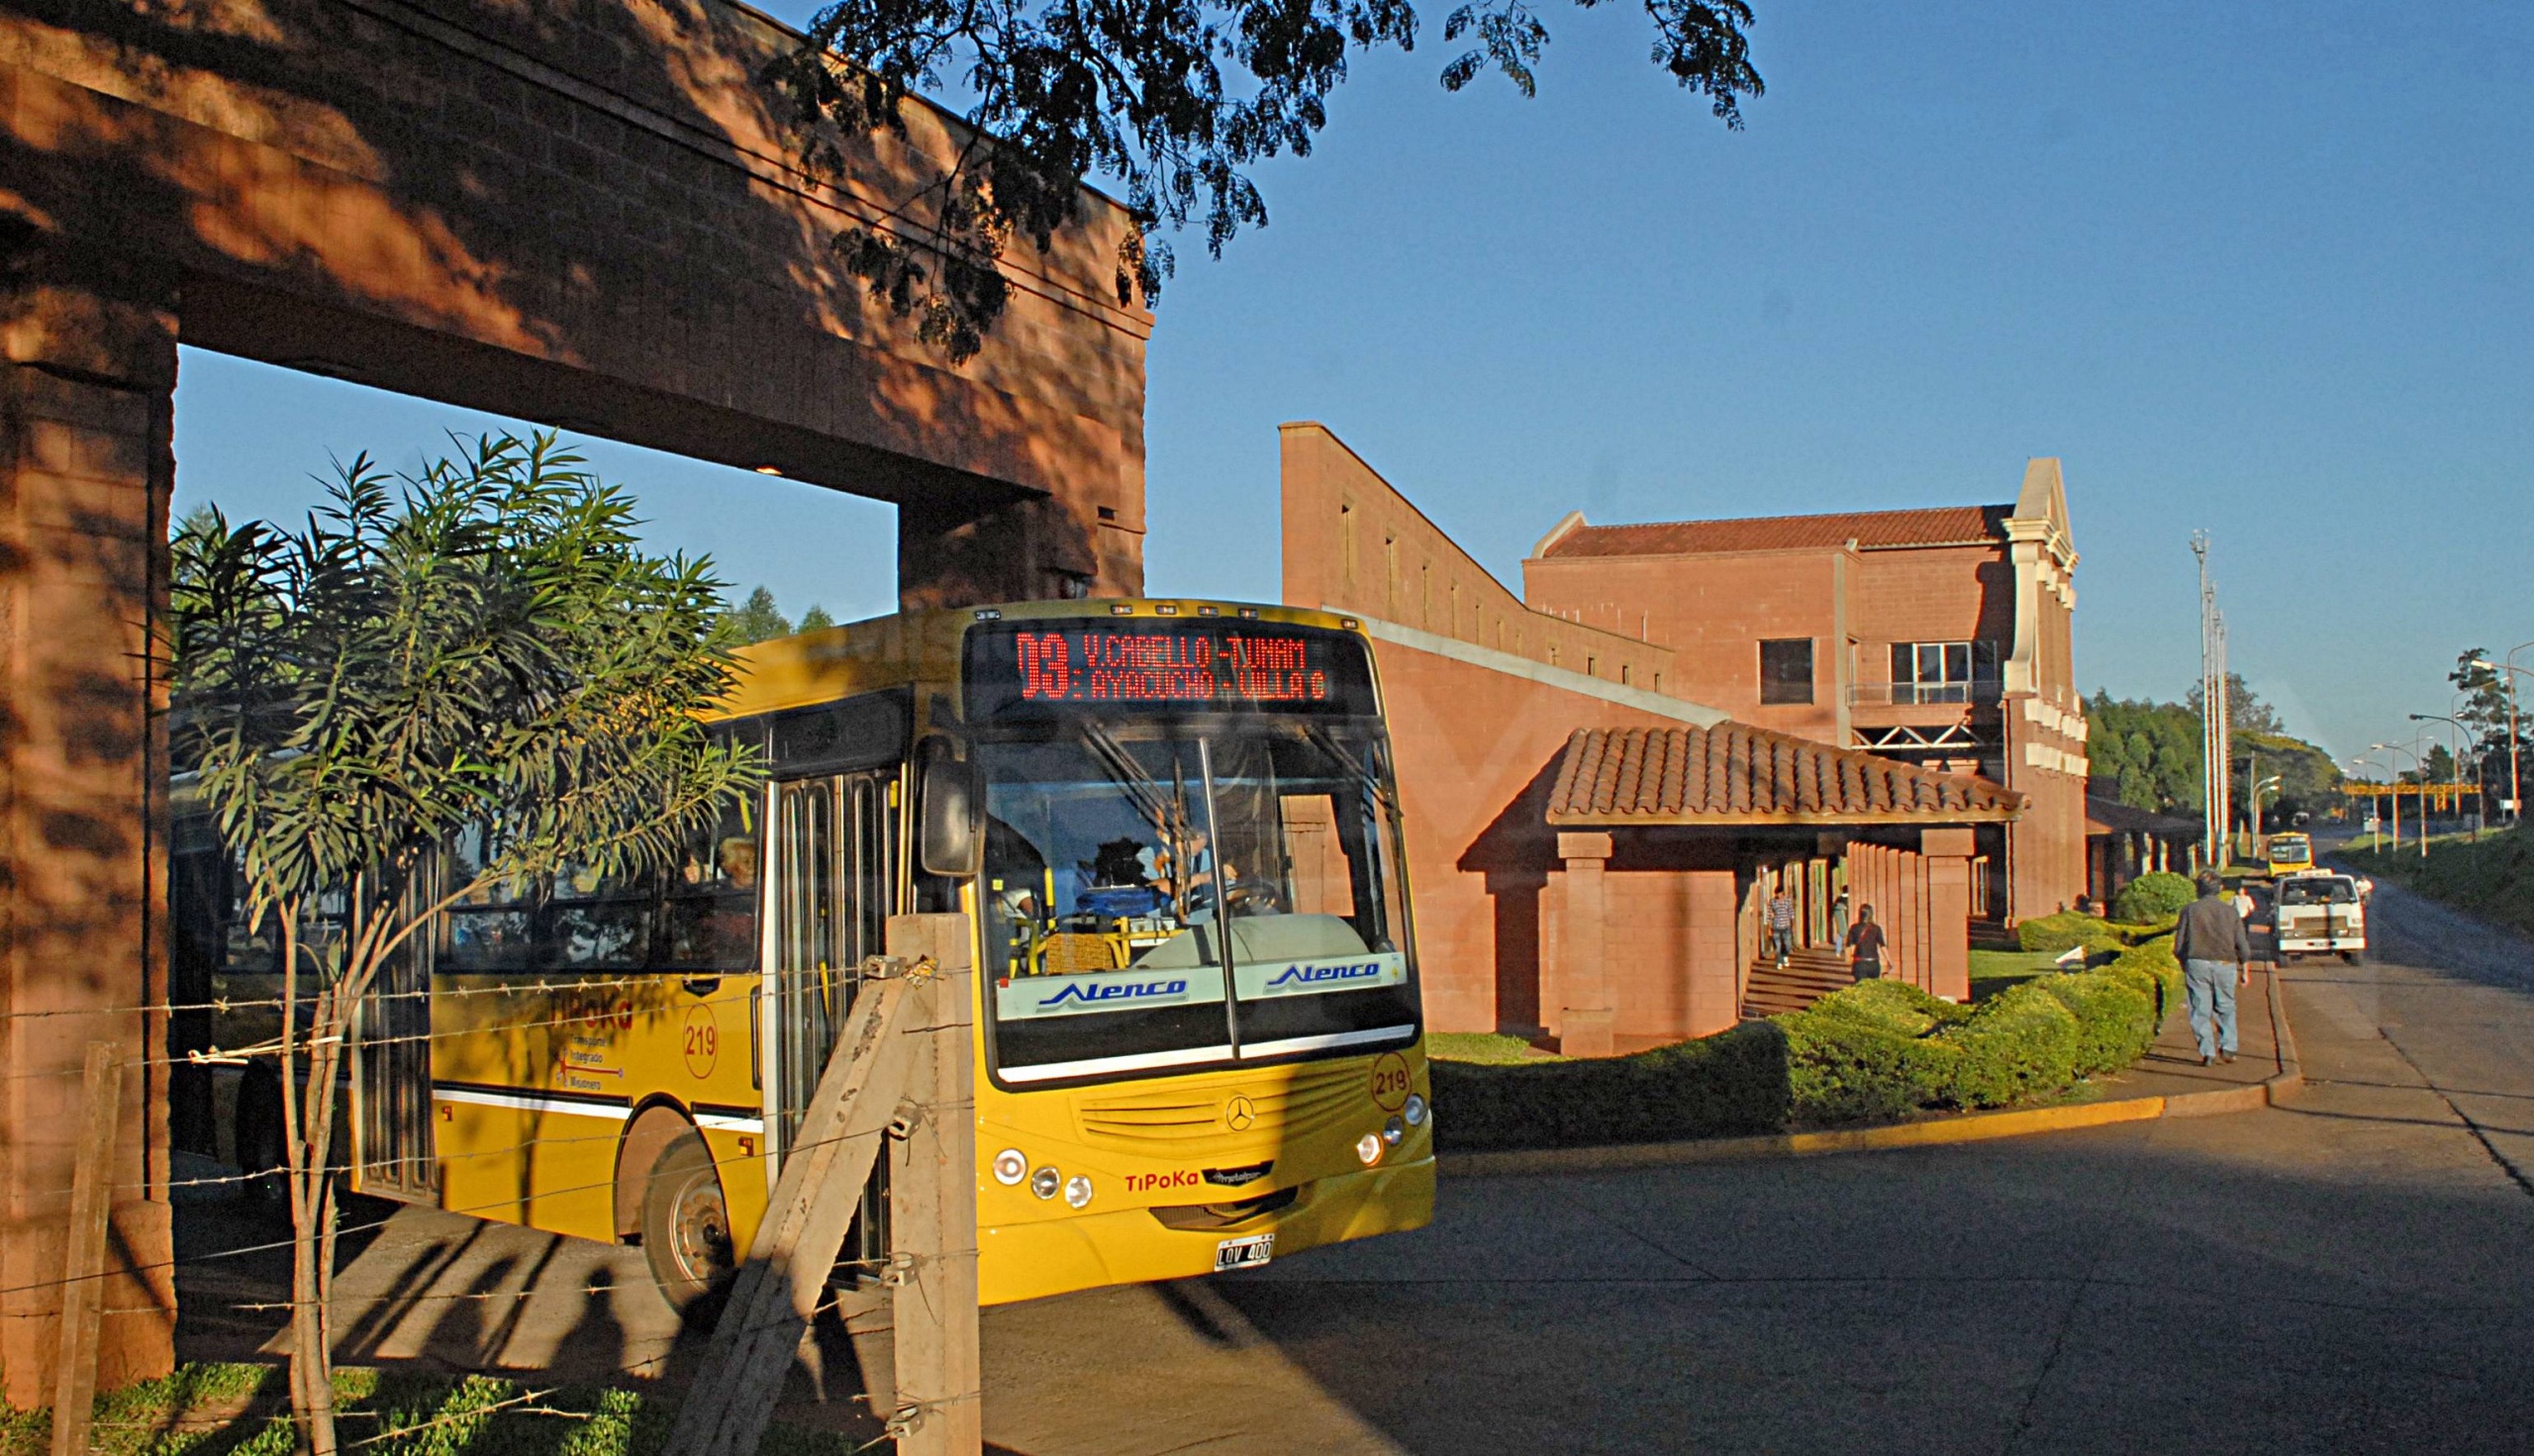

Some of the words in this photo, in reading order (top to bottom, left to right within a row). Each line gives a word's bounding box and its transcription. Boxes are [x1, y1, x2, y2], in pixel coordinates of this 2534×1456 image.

[1091, 670, 1216, 700] AYACUCHO
[1238, 671, 1305, 700] VILLA
[1266, 962, 1380, 987] Alenco
[1038, 979, 1188, 1006] Alenco
[685, 1024, 717, 1056] 219
[1375, 1069, 1408, 1096] 219
[1246, 1241, 1272, 1261] 400
